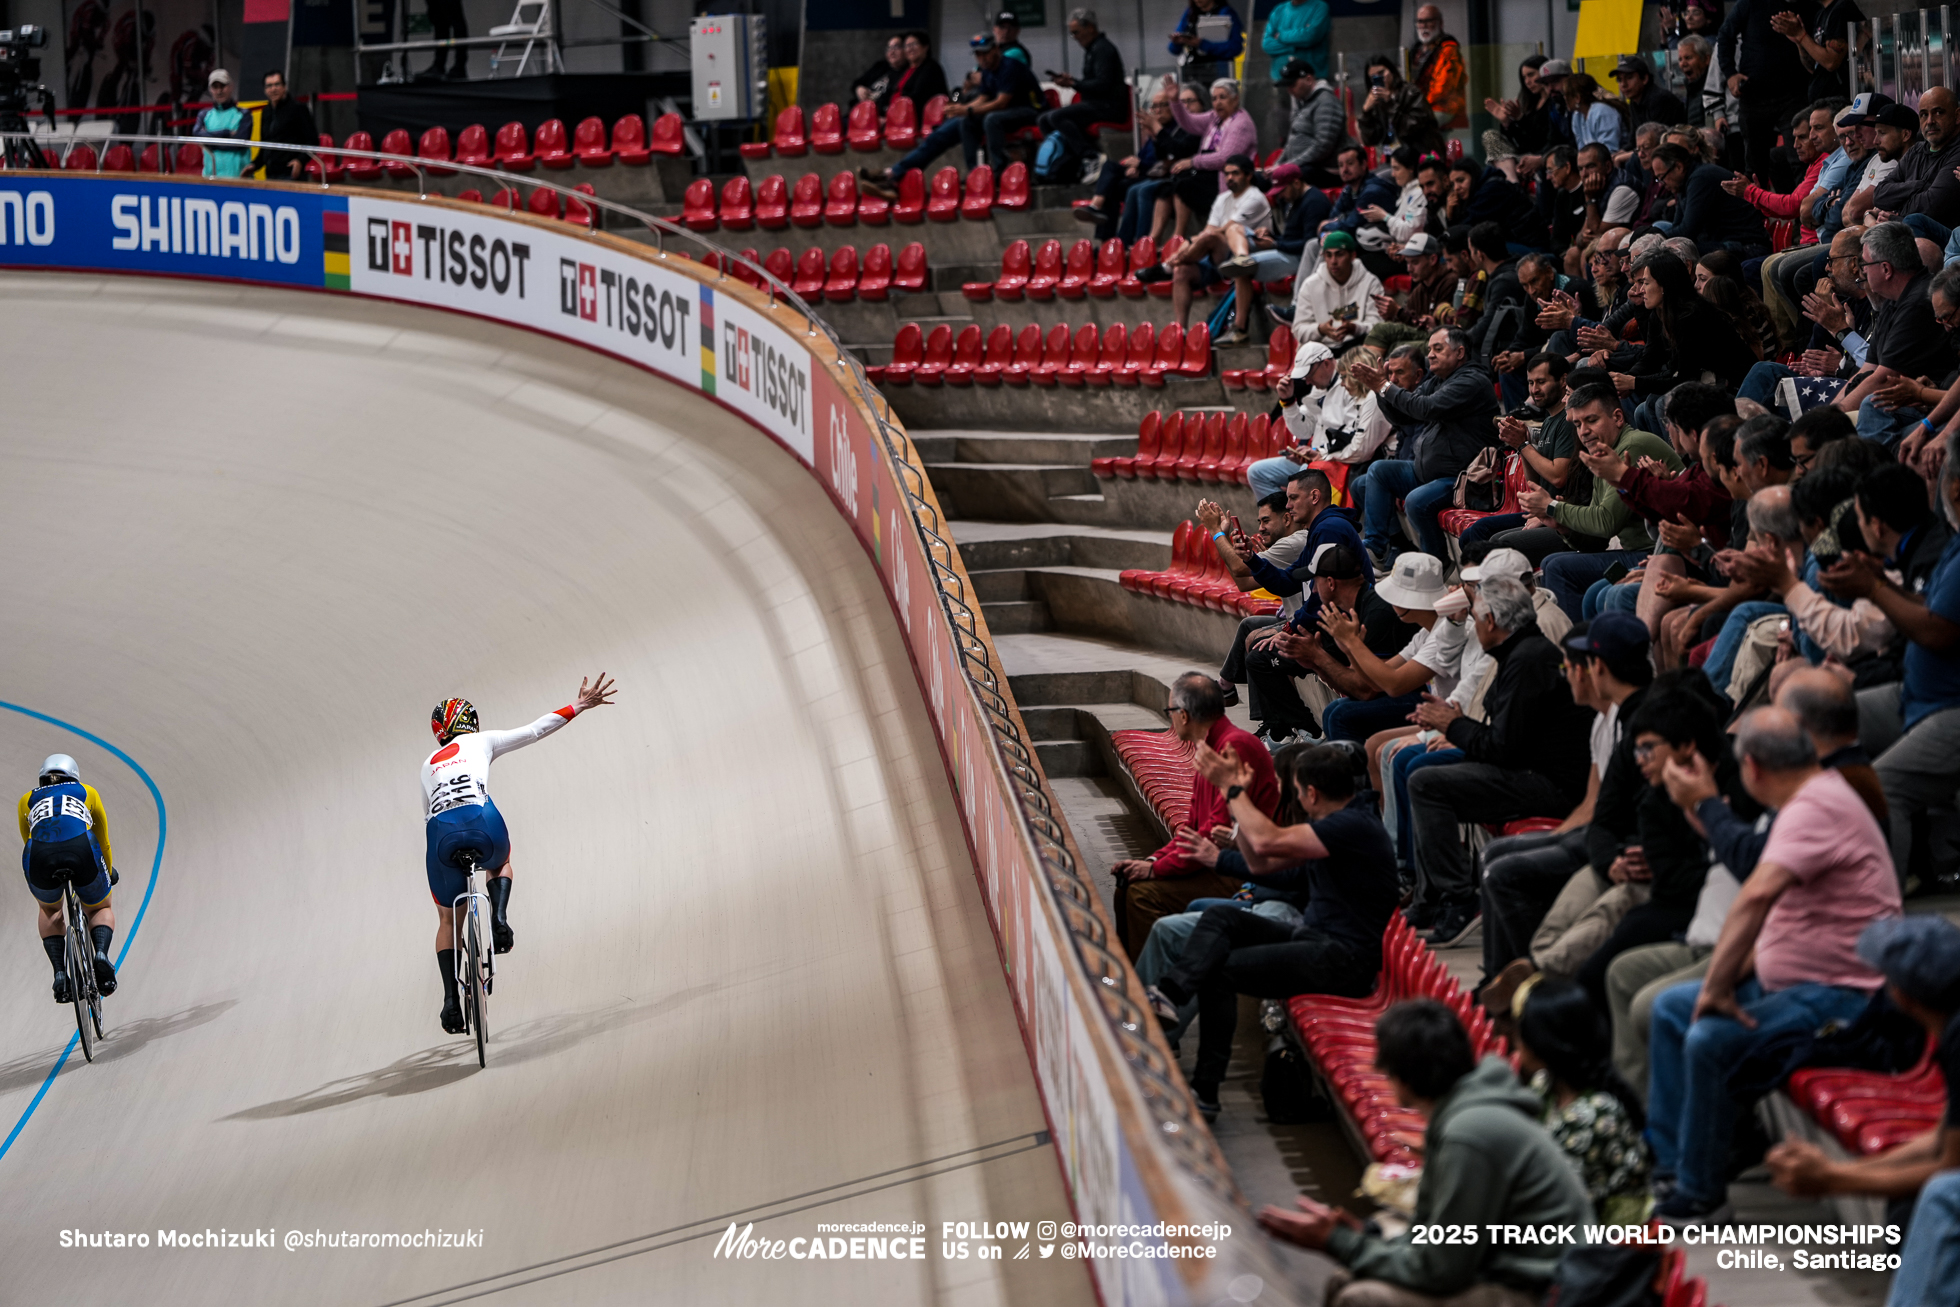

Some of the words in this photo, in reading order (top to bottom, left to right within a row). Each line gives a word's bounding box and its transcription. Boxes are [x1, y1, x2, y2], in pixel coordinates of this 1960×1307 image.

[111, 194, 300, 264] SHIMANO
[417, 224, 530, 299] TISSOT
[601, 268, 690, 356] TISSOT
[751, 334, 806, 435] TISSOT
[830, 403, 858, 519] Chile
[430, 758, 467, 777] JAPAN
